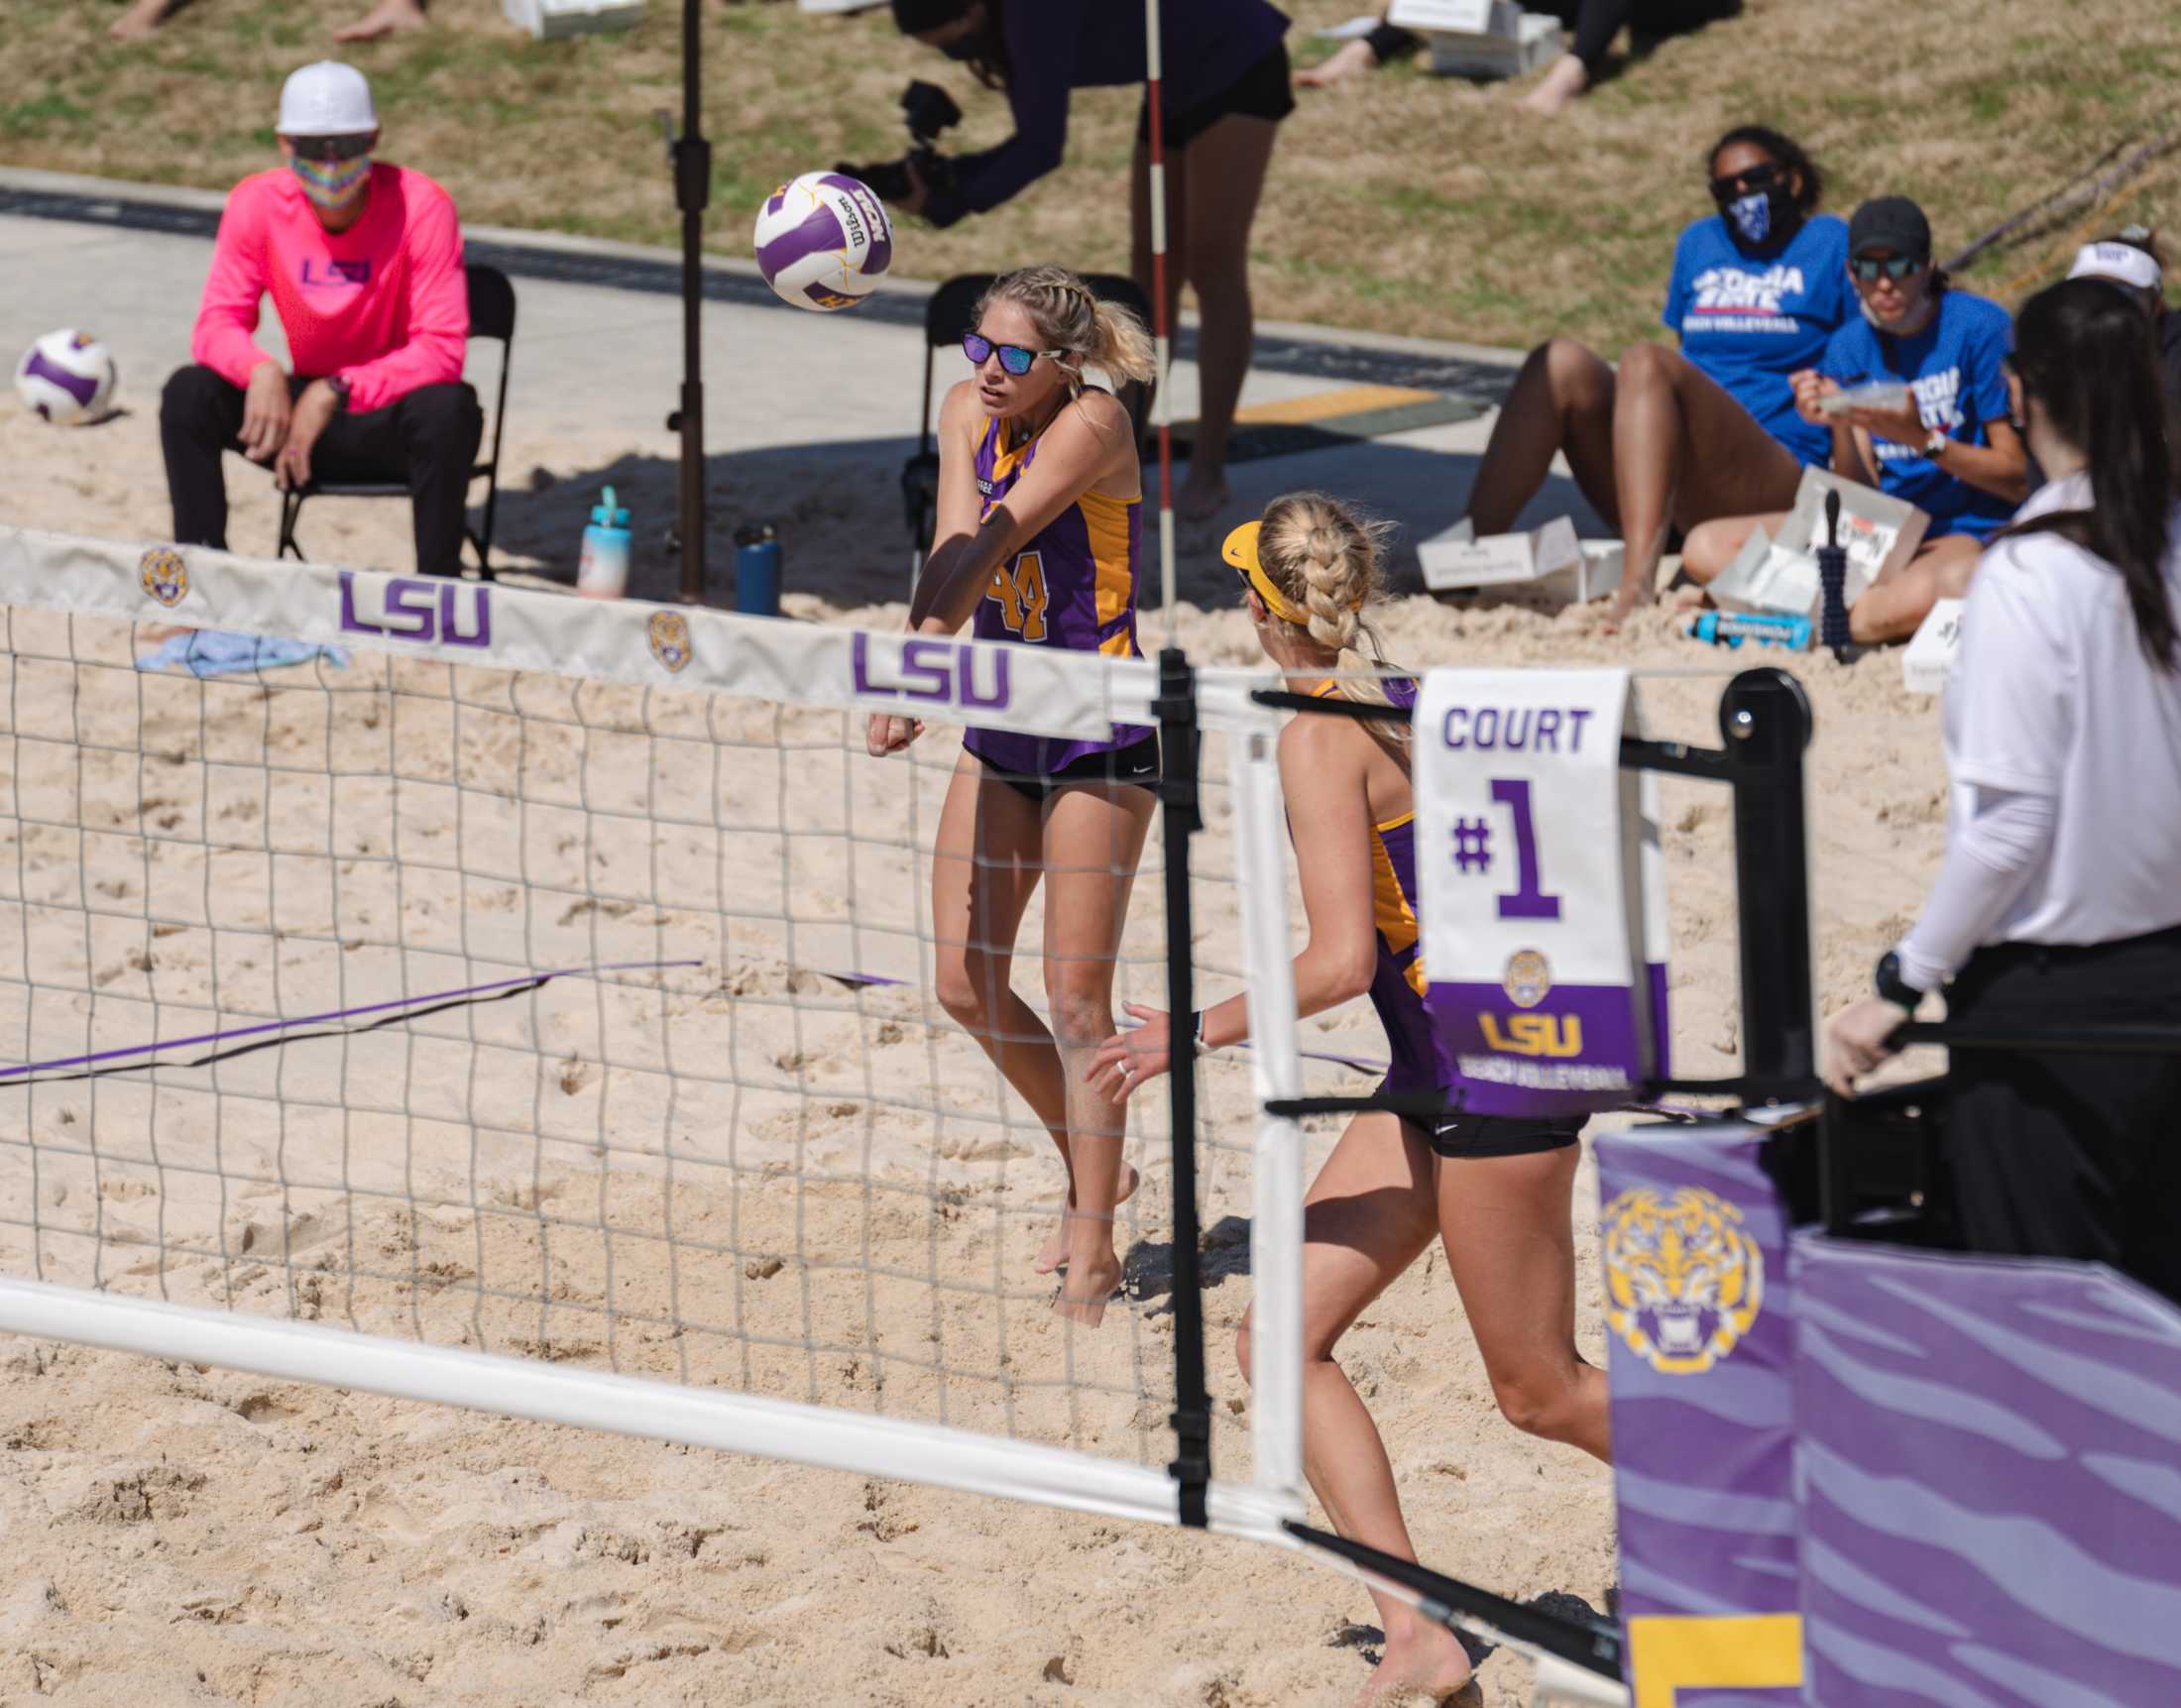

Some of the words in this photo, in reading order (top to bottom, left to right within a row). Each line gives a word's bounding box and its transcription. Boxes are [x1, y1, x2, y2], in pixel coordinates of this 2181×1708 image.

[838, 196, 864, 248] Wilson
[301, 258, 370, 285] LSU
[1692, 265, 1803, 296] ORIA
[338, 571, 490, 648] LSU
[985, 550, 1051, 642] 44
[854, 631, 1010, 709] LSU
[1443, 708, 1593, 753] COURT
[1453, 779, 1561, 918] #1
[1477, 1011, 1583, 1058] LSU
